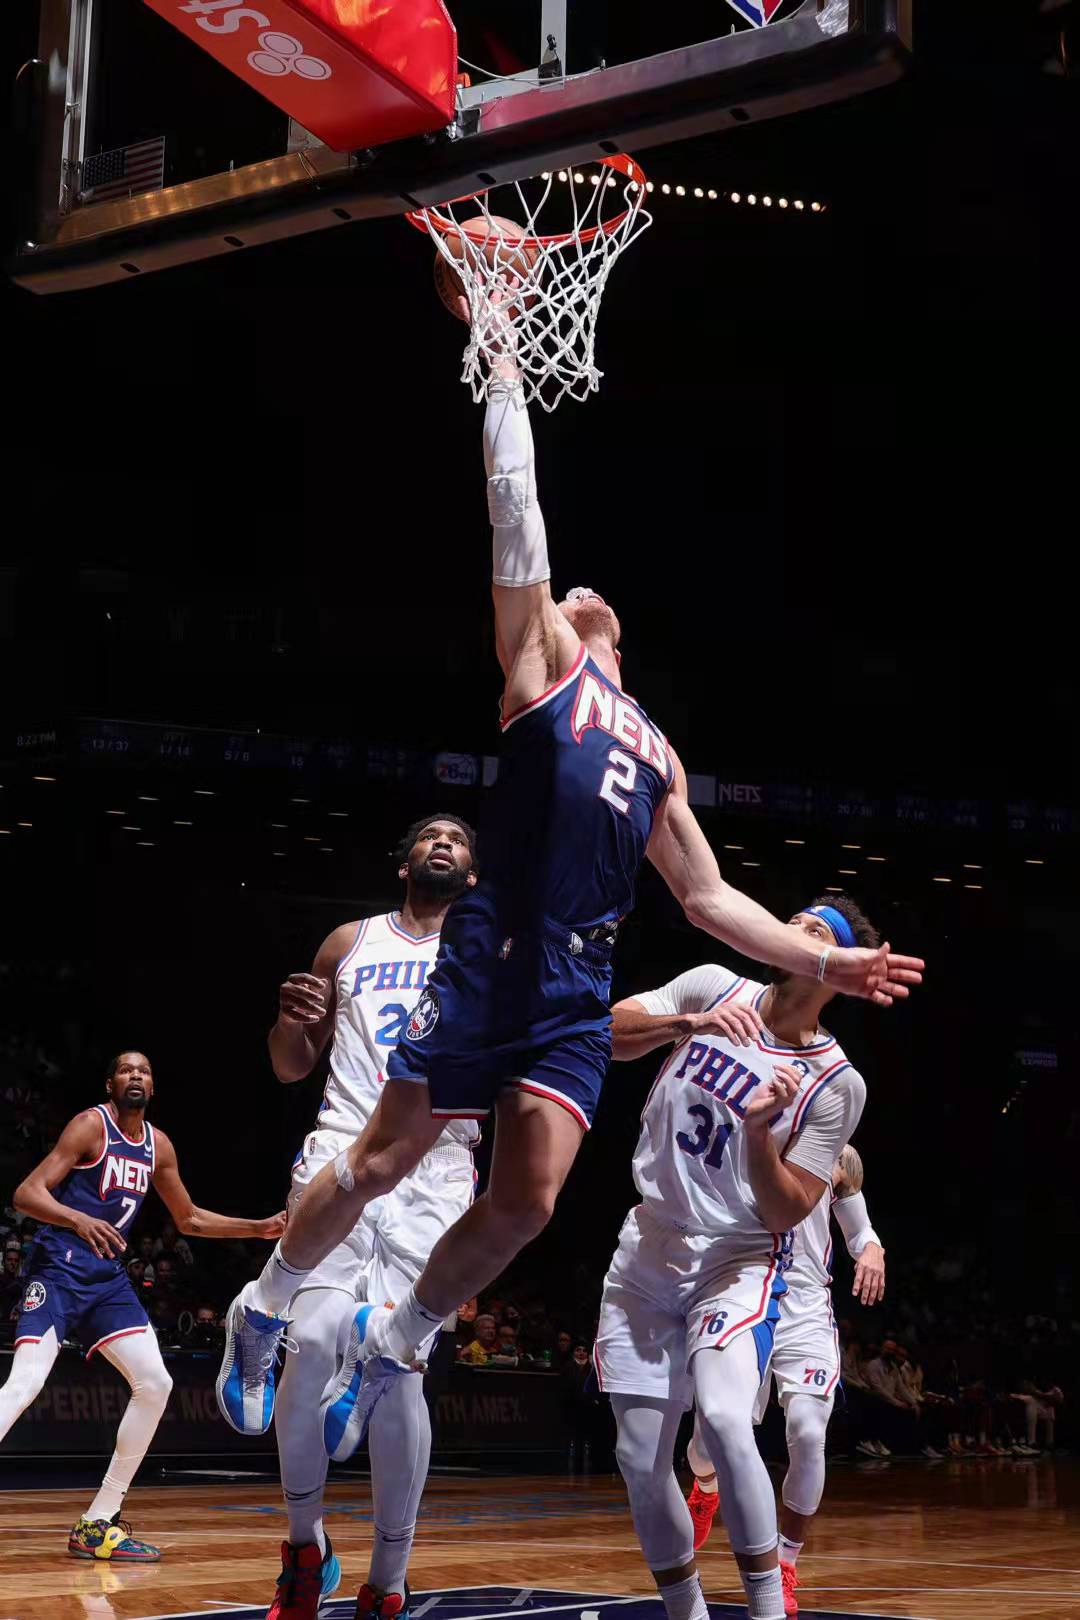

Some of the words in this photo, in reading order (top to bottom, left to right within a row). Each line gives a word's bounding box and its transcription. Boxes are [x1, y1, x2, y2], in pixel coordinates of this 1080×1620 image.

[571, 669, 668, 780] NETS
[599, 748, 638, 814] 2
[719, 783, 763, 803] NETS
[351, 961, 430, 997] PHIL
[674, 1041, 783, 1128] PHIL
[676, 1103, 733, 1169] 31
[101, 1153, 152, 1200] NETS
[113, 1196, 137, 1230] 7
[698, 1311, 728, 1336] 76
[803, 1368, 827, 1386] 76
[434, 1392, 466, 1423] ITH
